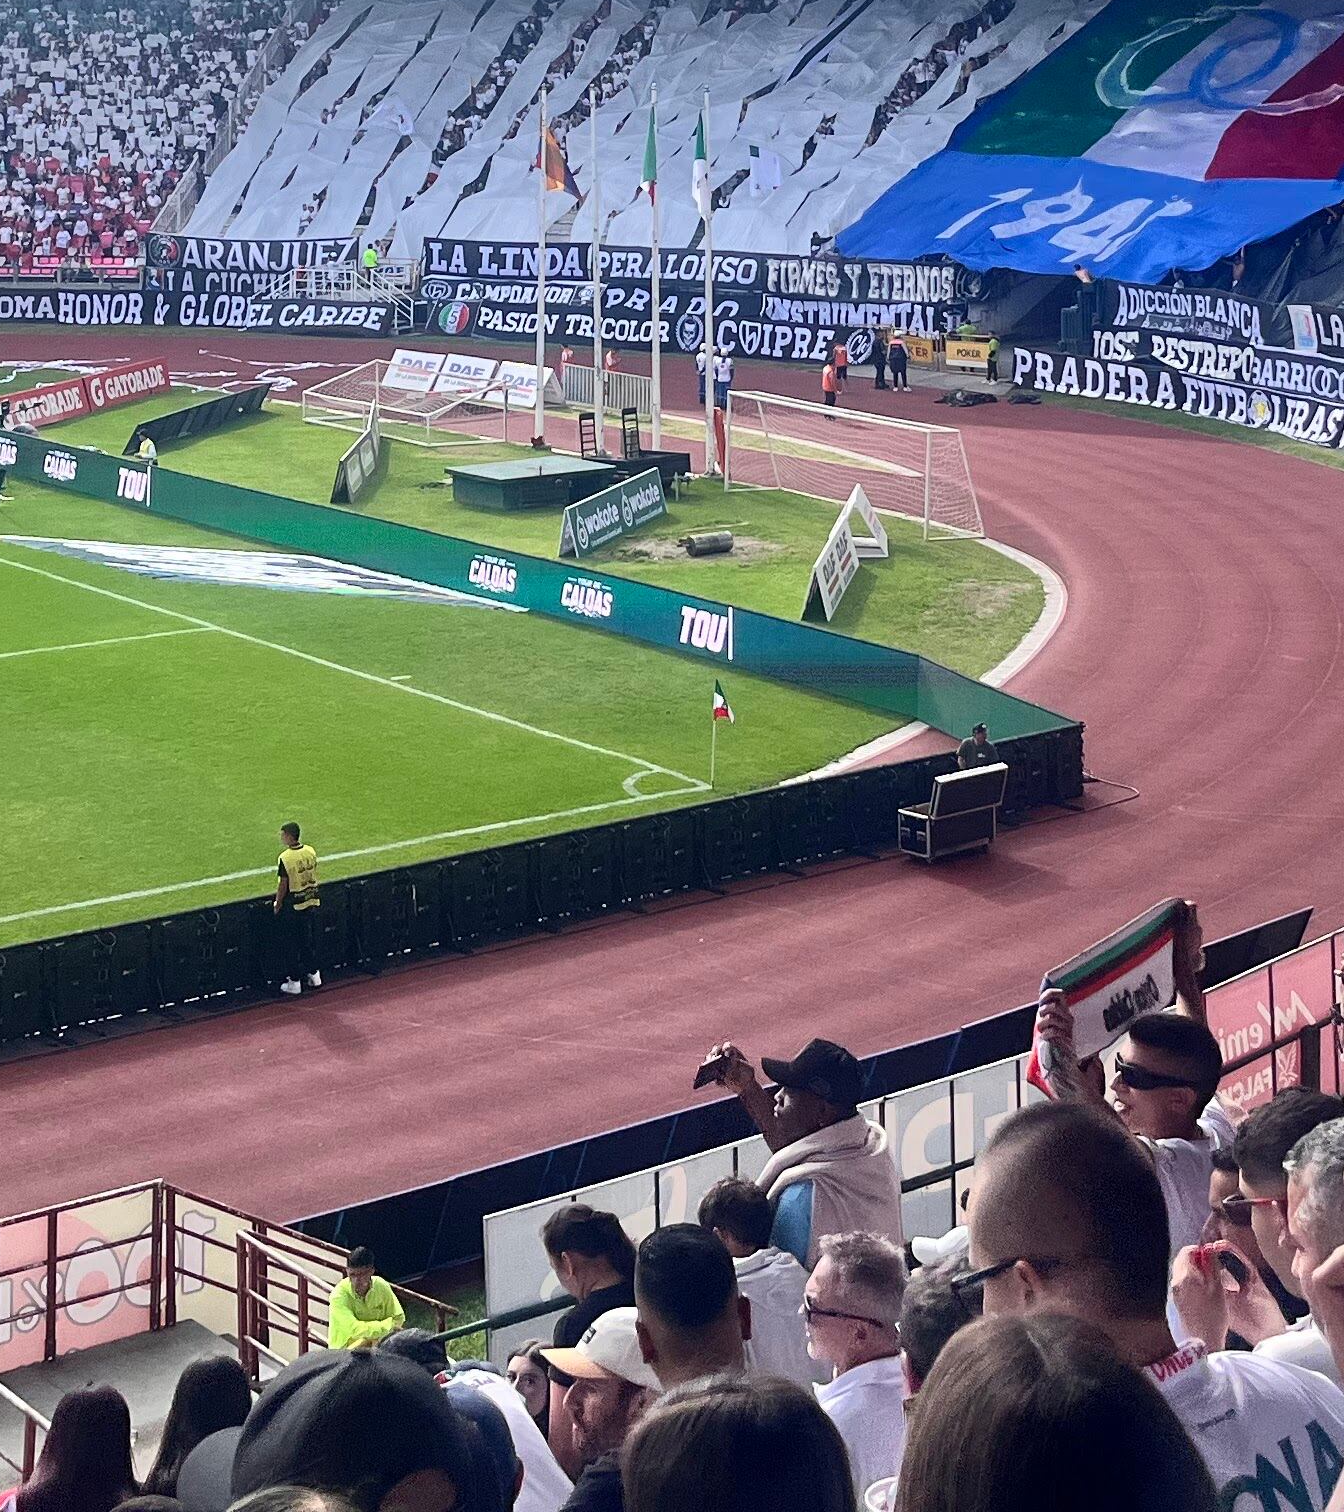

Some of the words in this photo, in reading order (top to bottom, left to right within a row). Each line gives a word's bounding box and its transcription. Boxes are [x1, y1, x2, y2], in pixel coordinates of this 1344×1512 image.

[182, 238, 357, 272] ARANJUEZ
[429, 242, 467, 274] LA
[478, 245, 584, 277] LINDA
[766, 258, 840, 298] FIRMES
[844, 262, 864, 299] Y
[867, 263, 955, 303] ETERNOS
[58, 292, 143, 325] HONOR
[153, 293, 170, 326] &
[248, 303, 273, 328] EL
[278, 303, 387, 331] CARIBE
[478, 306, 561, 335] PASION
[766, 296, 941, 338] INSTRUMENTAL
[1113, 285, 1192, 326] ADICCIÓN
[1195, 294, 1263, 346] BLANCA
[956, 348, 981, 358] POKER
[1152, 335, 1256, 383] RESTREPO
[104, 364, 165, 401] GATORADE
[400, 358, 436, 371] DAF
[448, 363, 485, 376] DAF
[503, 373, 537, 388] DAF
[1013, 347, 1177, 411] PRADERA
[44, 453, 78, 481] CALDAS
[823, 552, 836, 585] DAF
[835, 531, 848, 562] DAF
[469, 559, 518, 593] CALDAS
[561, 582, 614, 617] CALDAS
